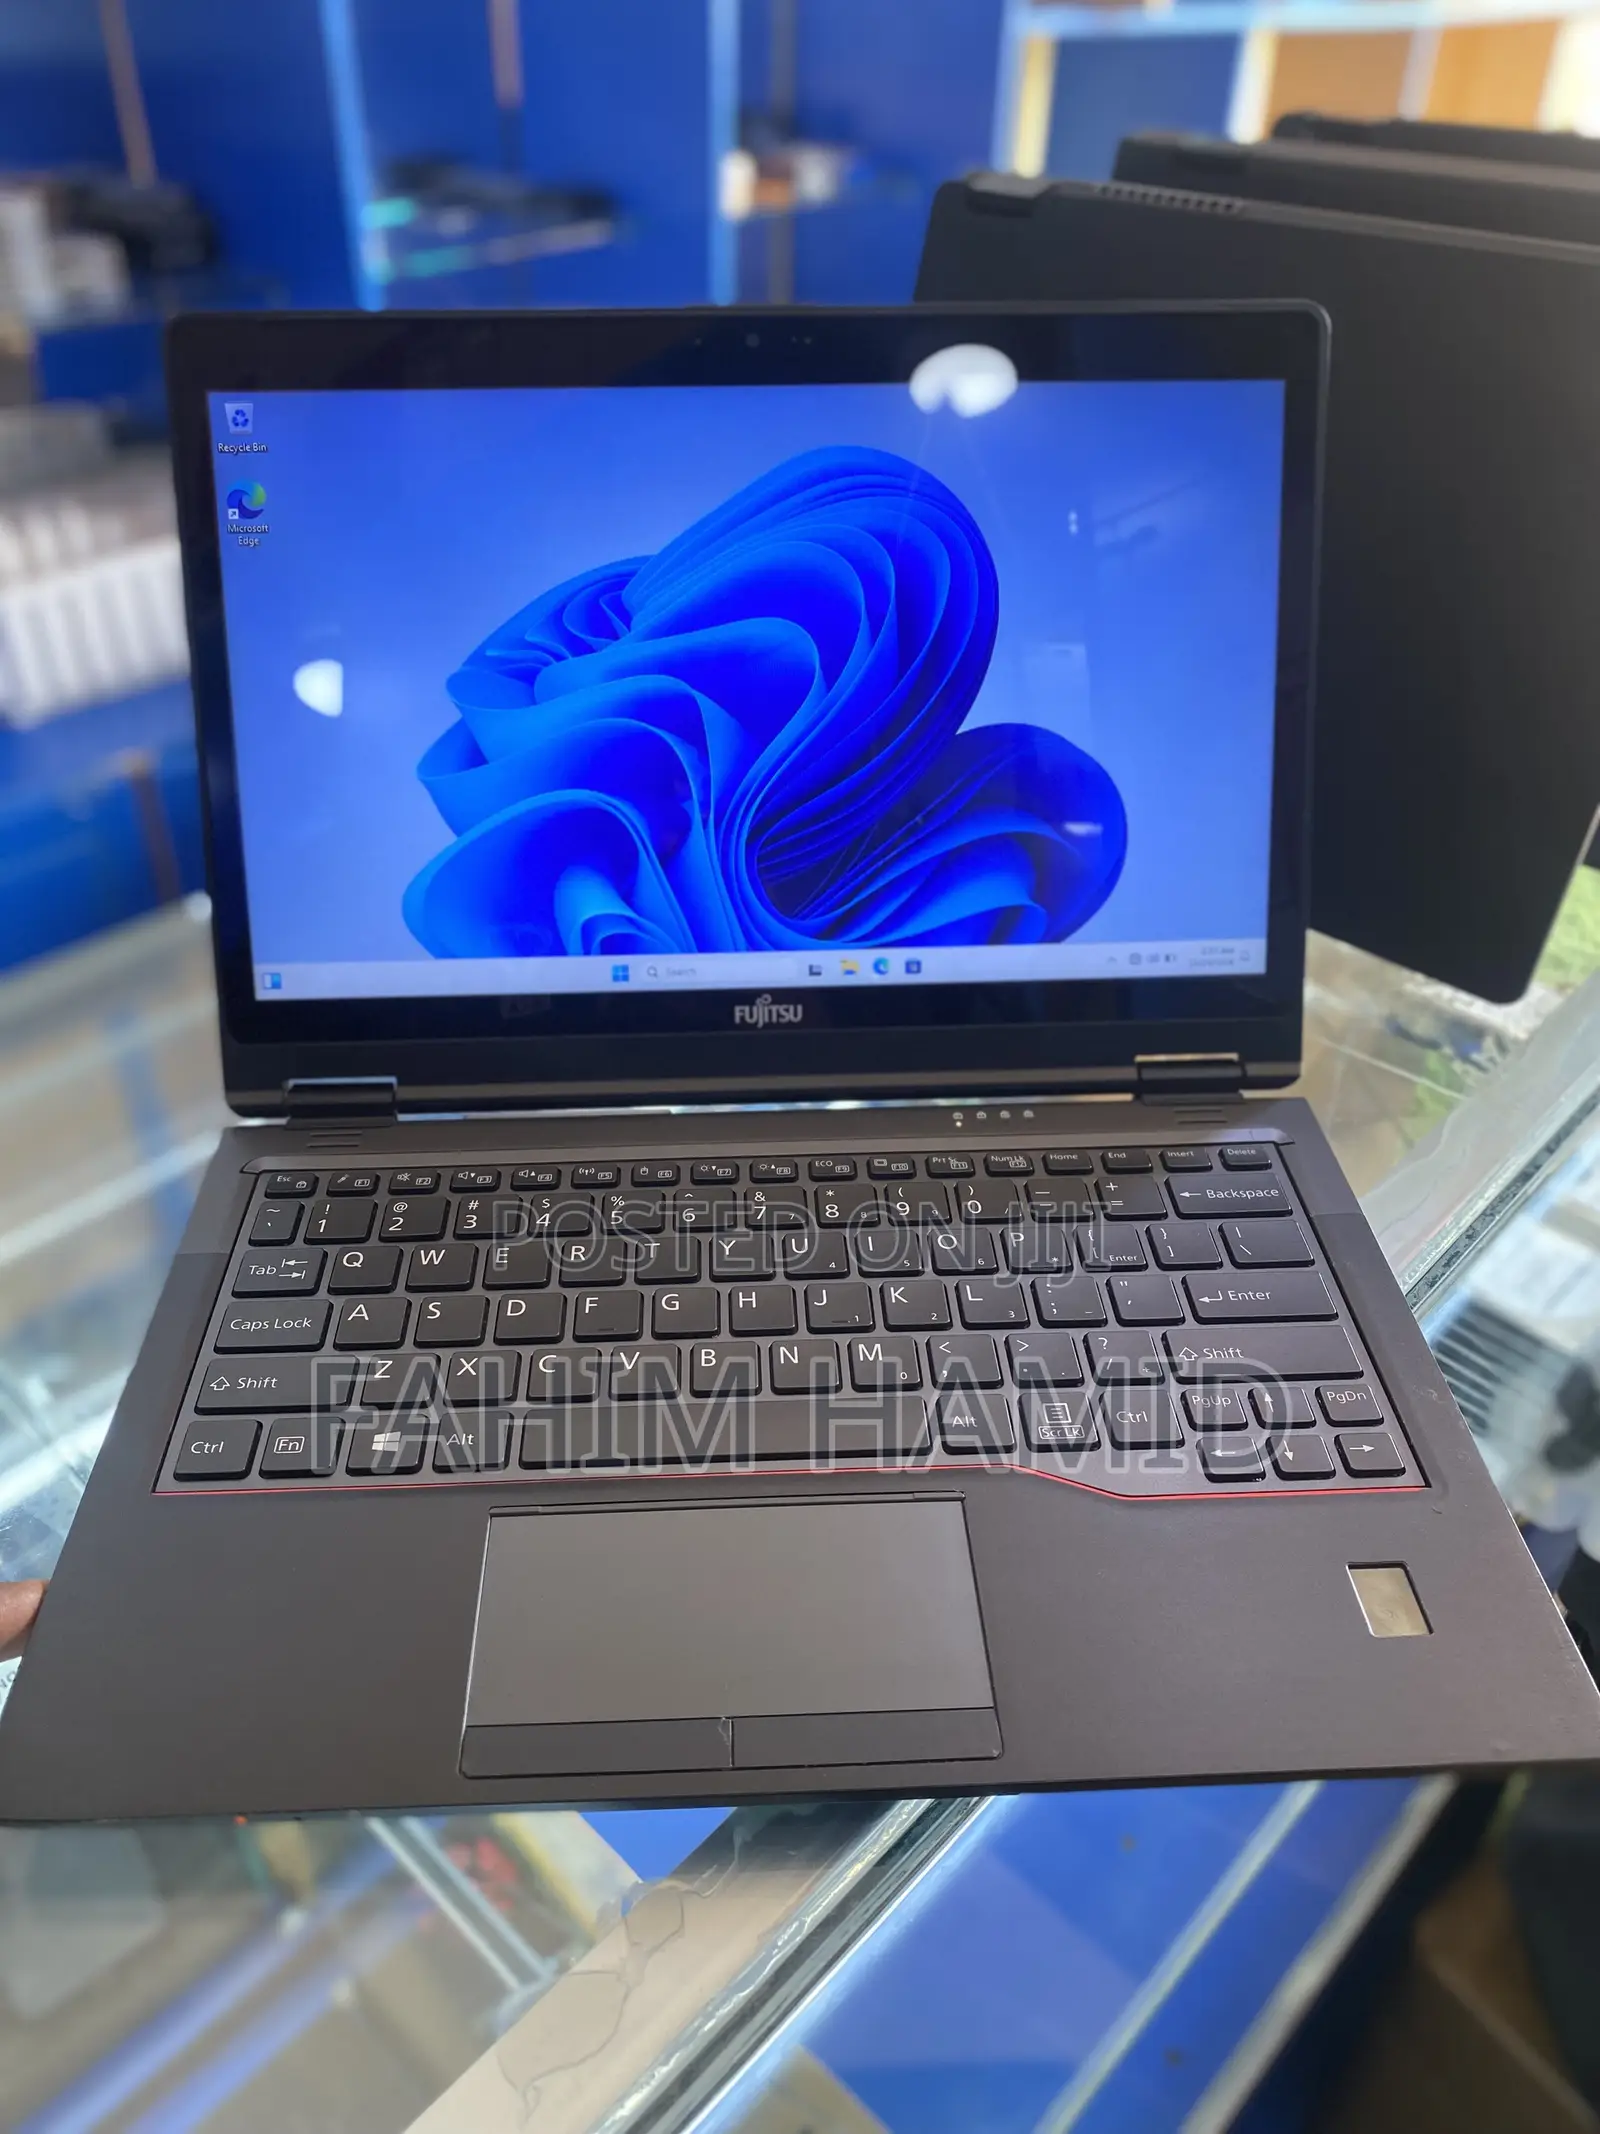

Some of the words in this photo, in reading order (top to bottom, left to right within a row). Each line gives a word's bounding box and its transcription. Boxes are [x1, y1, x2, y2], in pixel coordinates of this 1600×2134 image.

[218, 443, 250, 454] Recycle
[252, 443, 267, 452] Bin
[227, 524, 269, 533] Microsoft
[237, 536, 259, 547] Edge
[734, 994, 803, 1029] FUJITSU
[1049, 1152, 1078, 1161] Home
[1167, 1150, 1195, 1158] Insert
[814, 1160, 833, 1168] ECO
[276, 1175, 291, 1183] Esc
[1105, 1182, 1118, 1192] +
[1206, 1187, 1279, 1199] Backspace
[610, 1195, 625, 1206] %
[754, 1191, 766, 1202] &
[324, 1204, 331, 1215] !
[393, 1201, 408, 1213] @
[468, 1199, 480, 1211] #
[825, 1204, 840, 1218] 8
[896, 1201, 910, 1216] 9
[967, 1200, 982, 1214] 0
[535, 1213, 551, 1227] 4
[610, 1211, 624, 1225] 5
[682, 1207, 696, 1222] 6
[753, 1206, 767, 1220] 7
[860, 1211, 868, 1219] 8
[317, 1219, 327, 1233] 1
[388, 1217, 404, 1231] 2
[463, 1214, 477, 1229] 3
[791, 1238, 809, 1254] U
[867, 1236, 873, 1252] I
[1009, 1232, 1025, 1247] P
[570, 1245, 586, 1261] R
[644, 1242, 661, 1260] T
[718, 1239, 736, 1256] Y
[342, 1251, 364, 1268] Q
[420, 1249, 446, 1265] W
[495, 1247, 510, 1264] E
[977, 1257, 985, 1265] 6
[1109, 1254, 1138, 1263] Enter
[829, 1261, 836, 1269] 4
[903, 1259, 910, 1267] 5
[248, 1265, 277, 1276] Tab
[813, 1289, 827, 1306] J
[890, 1286, 909, 1304] K
[966, 1284, 984, 1301] L
[1227, 1289, 1272, 1301] Enter
[584, 1297, 599, 1314] F
[661, 1293, 680, 1311] G
[738, 1291, 757, 1309] H
[347, 1303, 369, 1321] A
[427, 1301, 442, 1320] S
[506, 1299, 527, 1316] D
[1008, 1310, 1015, 1318] 3
[230, 1319, 270, 1332] Caps
[274, 1317, 312, 1329] Lock
[938, 1341, 952, 1354] <
[1016, 1339, 1030, 1352] >
[1098, 1337, 1108, 1350] ?
[700, 1348, 717, 1367] B
[779, 1346, 799, 1364] N
[858, 1343, 883, 1362] M
[1203, 1347, 1244, 1360] Shift
[456, 1357, 479, 1376] X
[538, 1354, 557, 1373] C
[619, 1351, 640, 1370] V
[373, 1360, 393, 1379] Z
[236, 1377, 278, 1389] Shift
[1191, 1395, 1232, 1408] PgUp
[1326, 1391, 1367, 1405] PgDn
[951, 1415, 978, 1428] Alt
[1115, 1410, 1148, 1424] Ctrl
[446, 1432, 475, 1446] Alt
[1041, 1427, 1062, 1438] Scr
[1065, 1426, 1081, 1438] Lk
[190, 1441, 224, 1454] Ctrl
[278, 1438, 300, 1451] Fn
